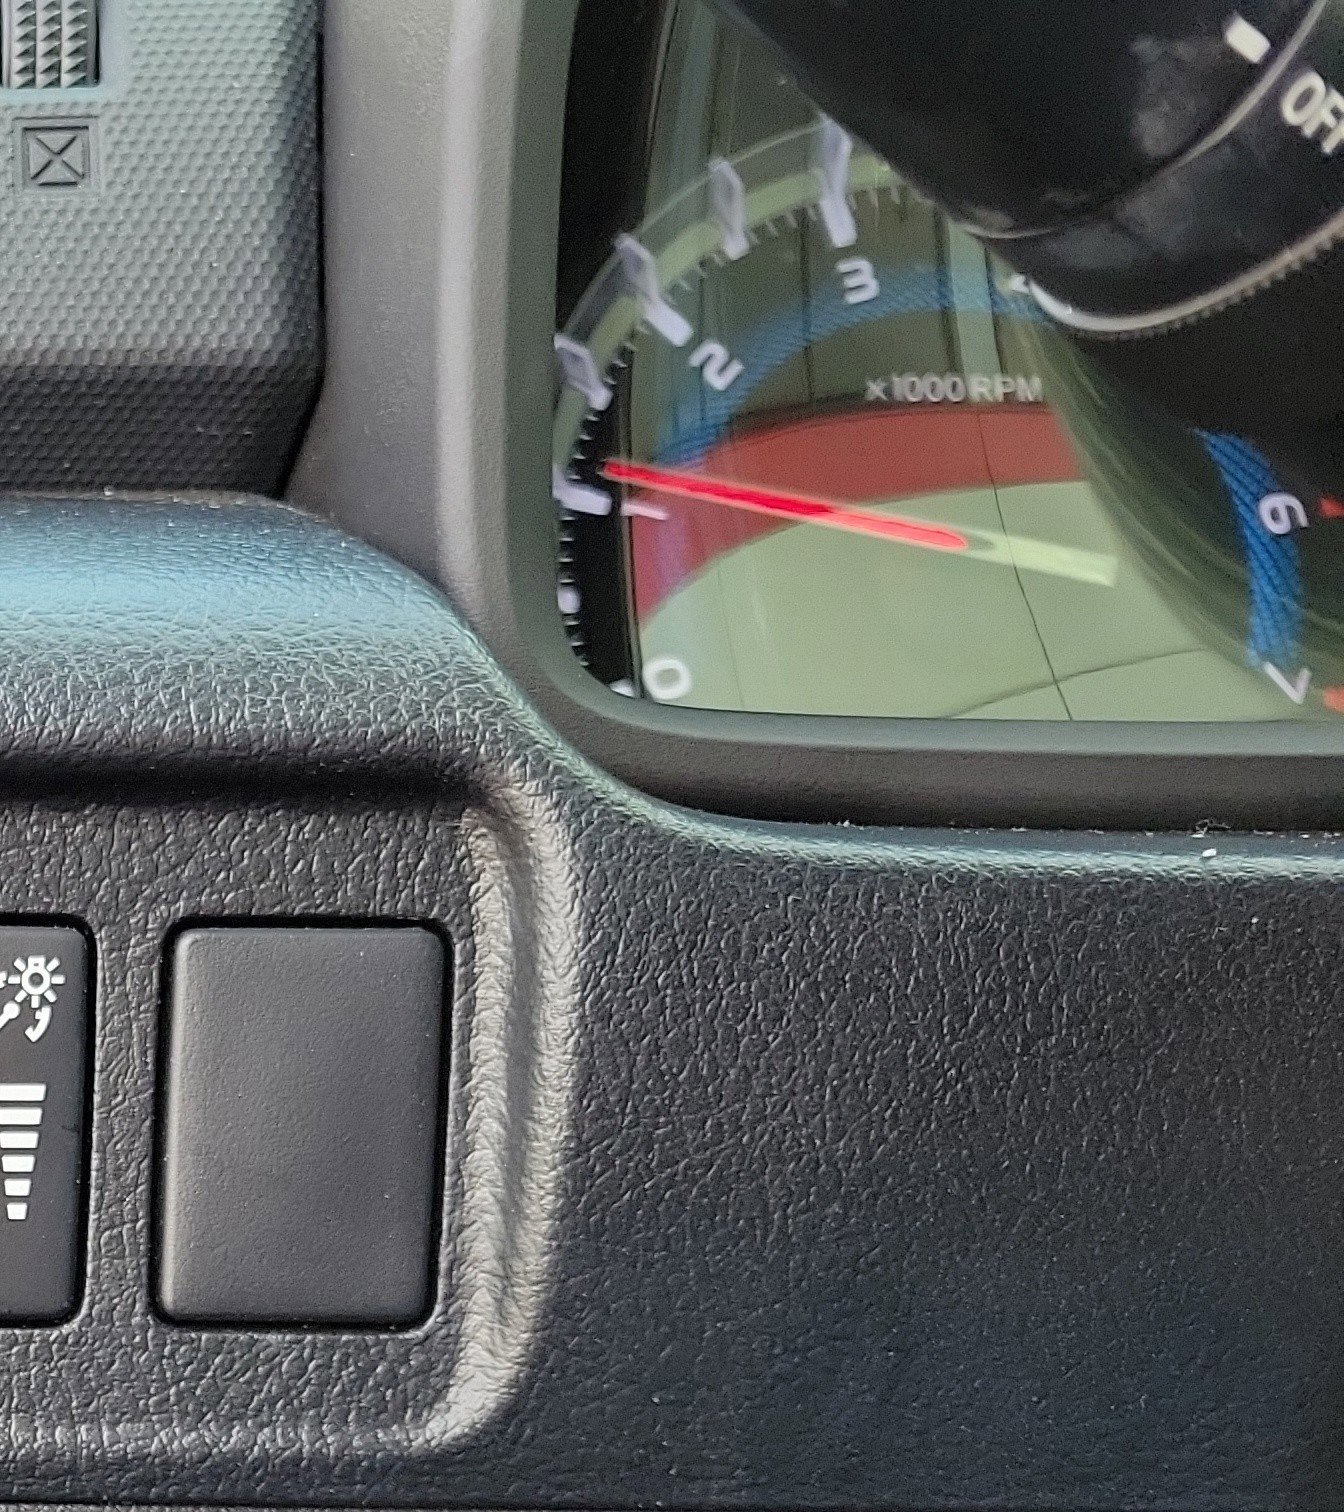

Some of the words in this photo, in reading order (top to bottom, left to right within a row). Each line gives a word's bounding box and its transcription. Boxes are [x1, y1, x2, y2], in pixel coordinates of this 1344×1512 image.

[834, 257, 880, 305] 3
[688, 338, 744, 391] 2
[968, 372, 1043, 402] RPM
[1259, 491, 1309, 535] 6
[642, 656, 692, 700] 0
[1264, 660, 1312, 704] 7
